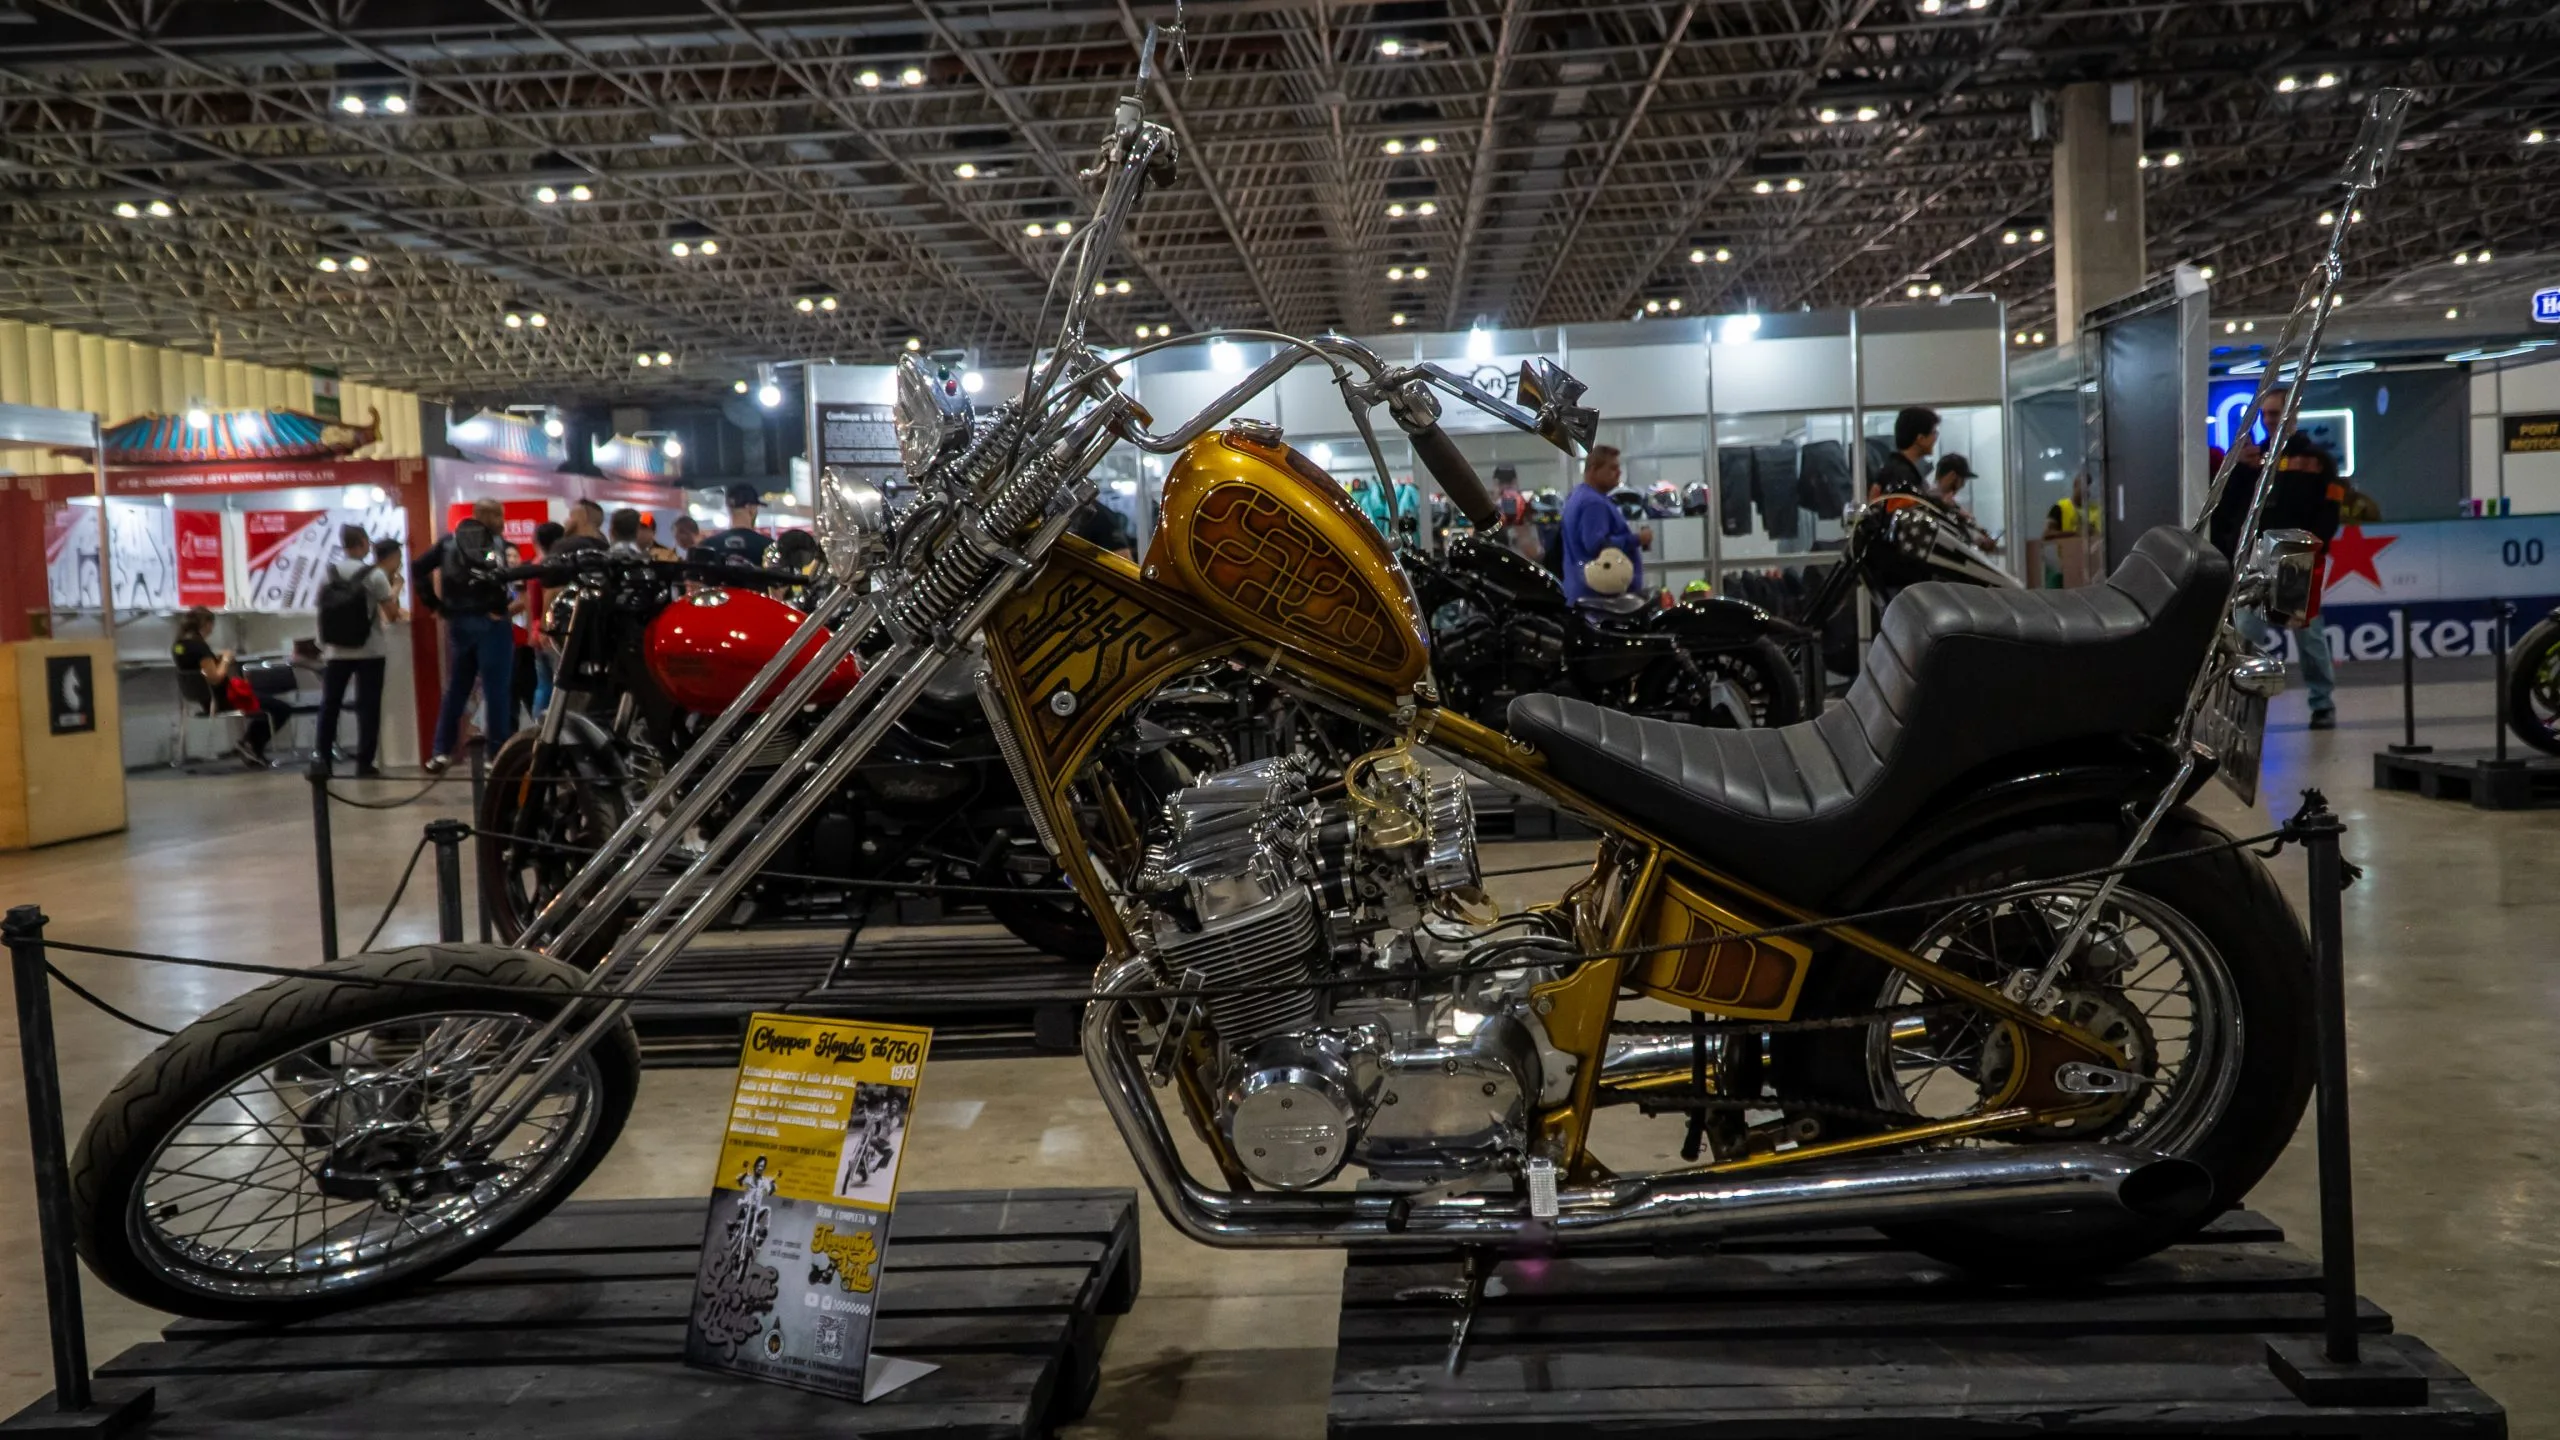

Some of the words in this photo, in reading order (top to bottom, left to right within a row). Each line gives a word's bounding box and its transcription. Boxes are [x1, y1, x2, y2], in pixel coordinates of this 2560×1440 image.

[2519, 422, 2559, 437] POINT
[752, 1026, 812, 1056] Chopper
[814, 1031, 867, 1064] Honda
